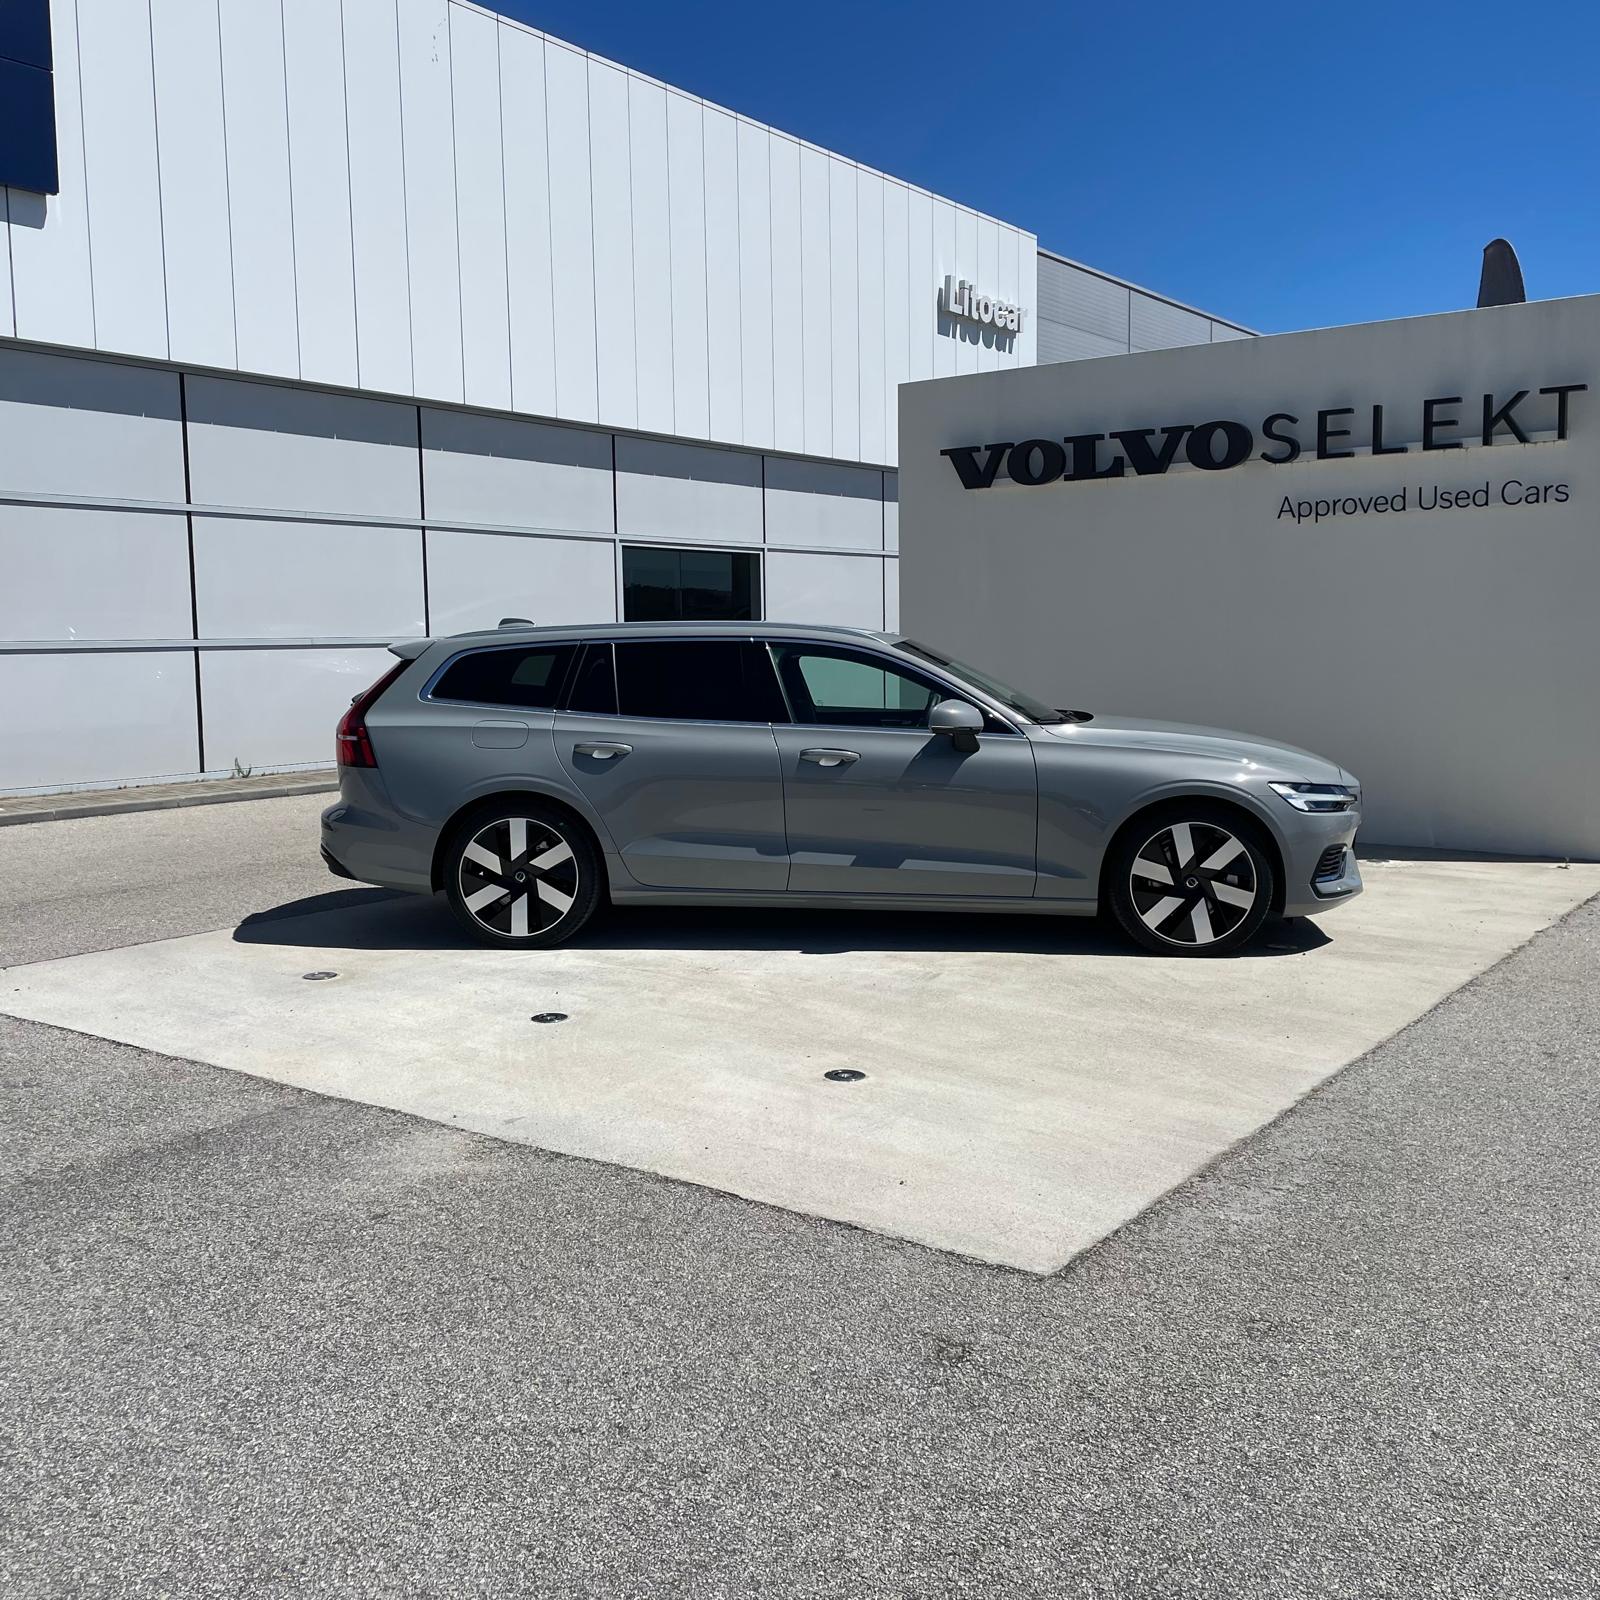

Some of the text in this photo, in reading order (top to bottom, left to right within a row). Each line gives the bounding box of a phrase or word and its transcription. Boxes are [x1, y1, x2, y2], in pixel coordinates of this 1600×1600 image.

[1277, 479, 1570, 524] Approved Used Cars
